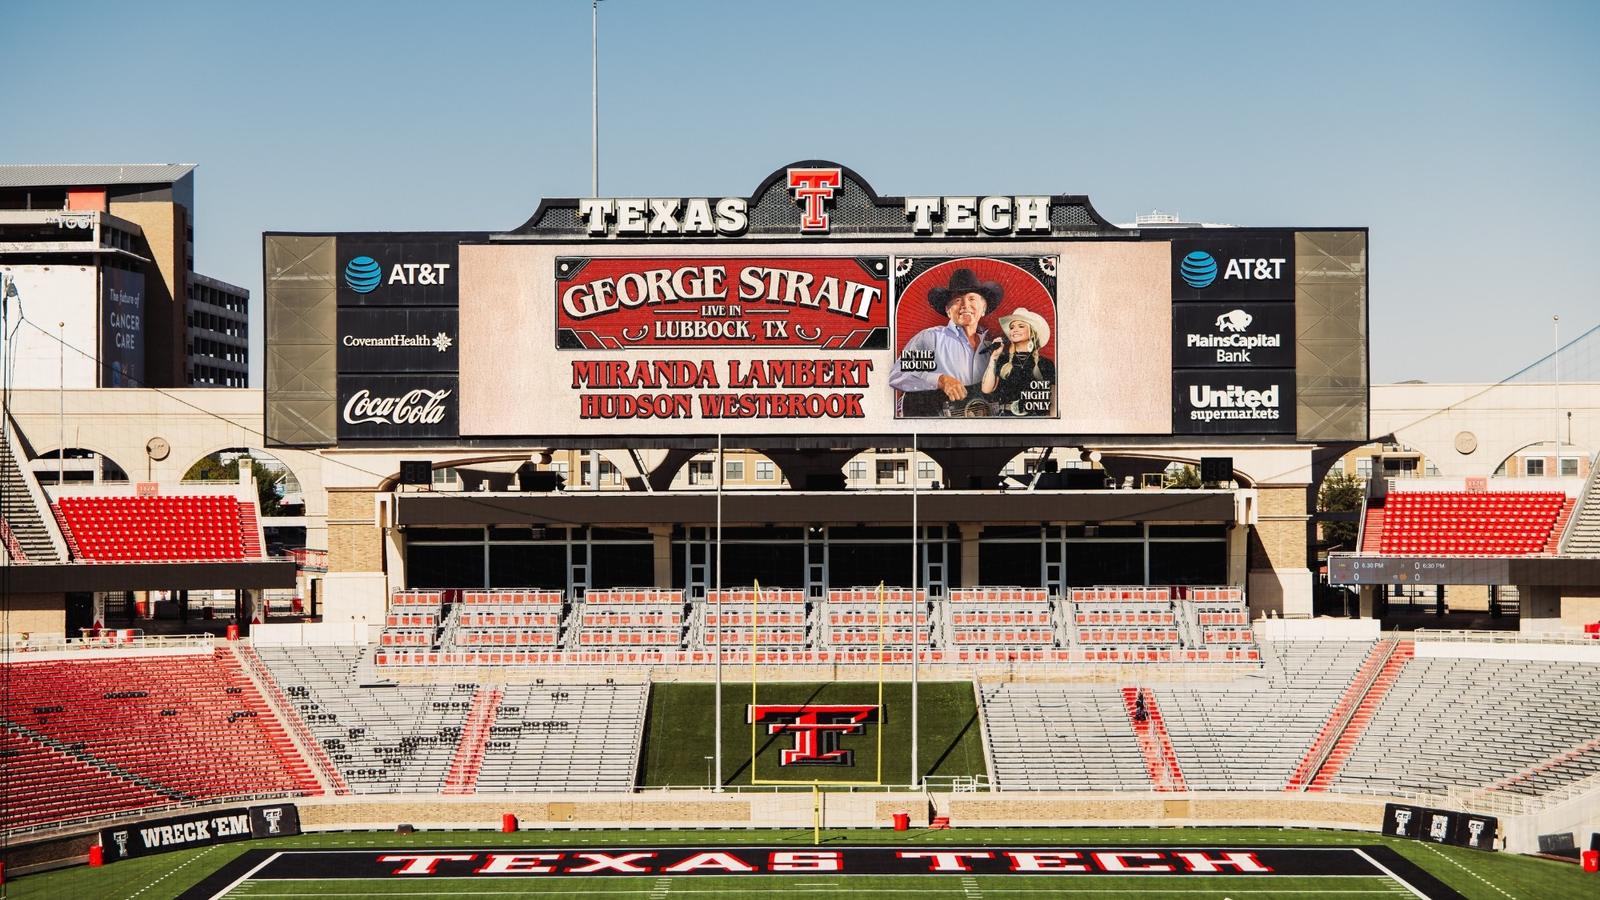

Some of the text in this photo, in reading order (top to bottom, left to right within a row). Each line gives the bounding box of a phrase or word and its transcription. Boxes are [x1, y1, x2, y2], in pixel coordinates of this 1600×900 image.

[580, 196, 1051, 235] TEXAS TECH
[388, 264, 450, 285] AT&T
[1224, 258, 1286, 280] AT&T
[562, 265, 881, 322] GEORGE STRAIT
[701, 305, 741, 317] LIVE IN
[110, 312, 140, 331] CANCER
[654, 321, 789, 341] LUBBOCK, TX
[115, 332, 135, 350] CARE
[343, 334, 431, 347] CovenantHealth
[1187, 334, 1280, 349] PlainsCapital
[901, 350, 934, 359] IN THE
[1216, 350, 1251, 362] Bank
[571, 360, 874, 389] MIRANDA LAMBERT
[1030, 380, 1050, 390] ONE
[1020, 391, 1050, 400] NIGHT
[1189, 385, 1279, 408] United
[343, 389, 452, 424] Coca-Cola
[580, 393, 865, 419] HUDSON WESTBROOK
[1025, 401, 1051, 411] ONLY
[1190, 408, 1280, 422] supermarkets
[140, 820, 211, 849] WRECK
[376, 851, 1274, 875] TEXAS TECH
